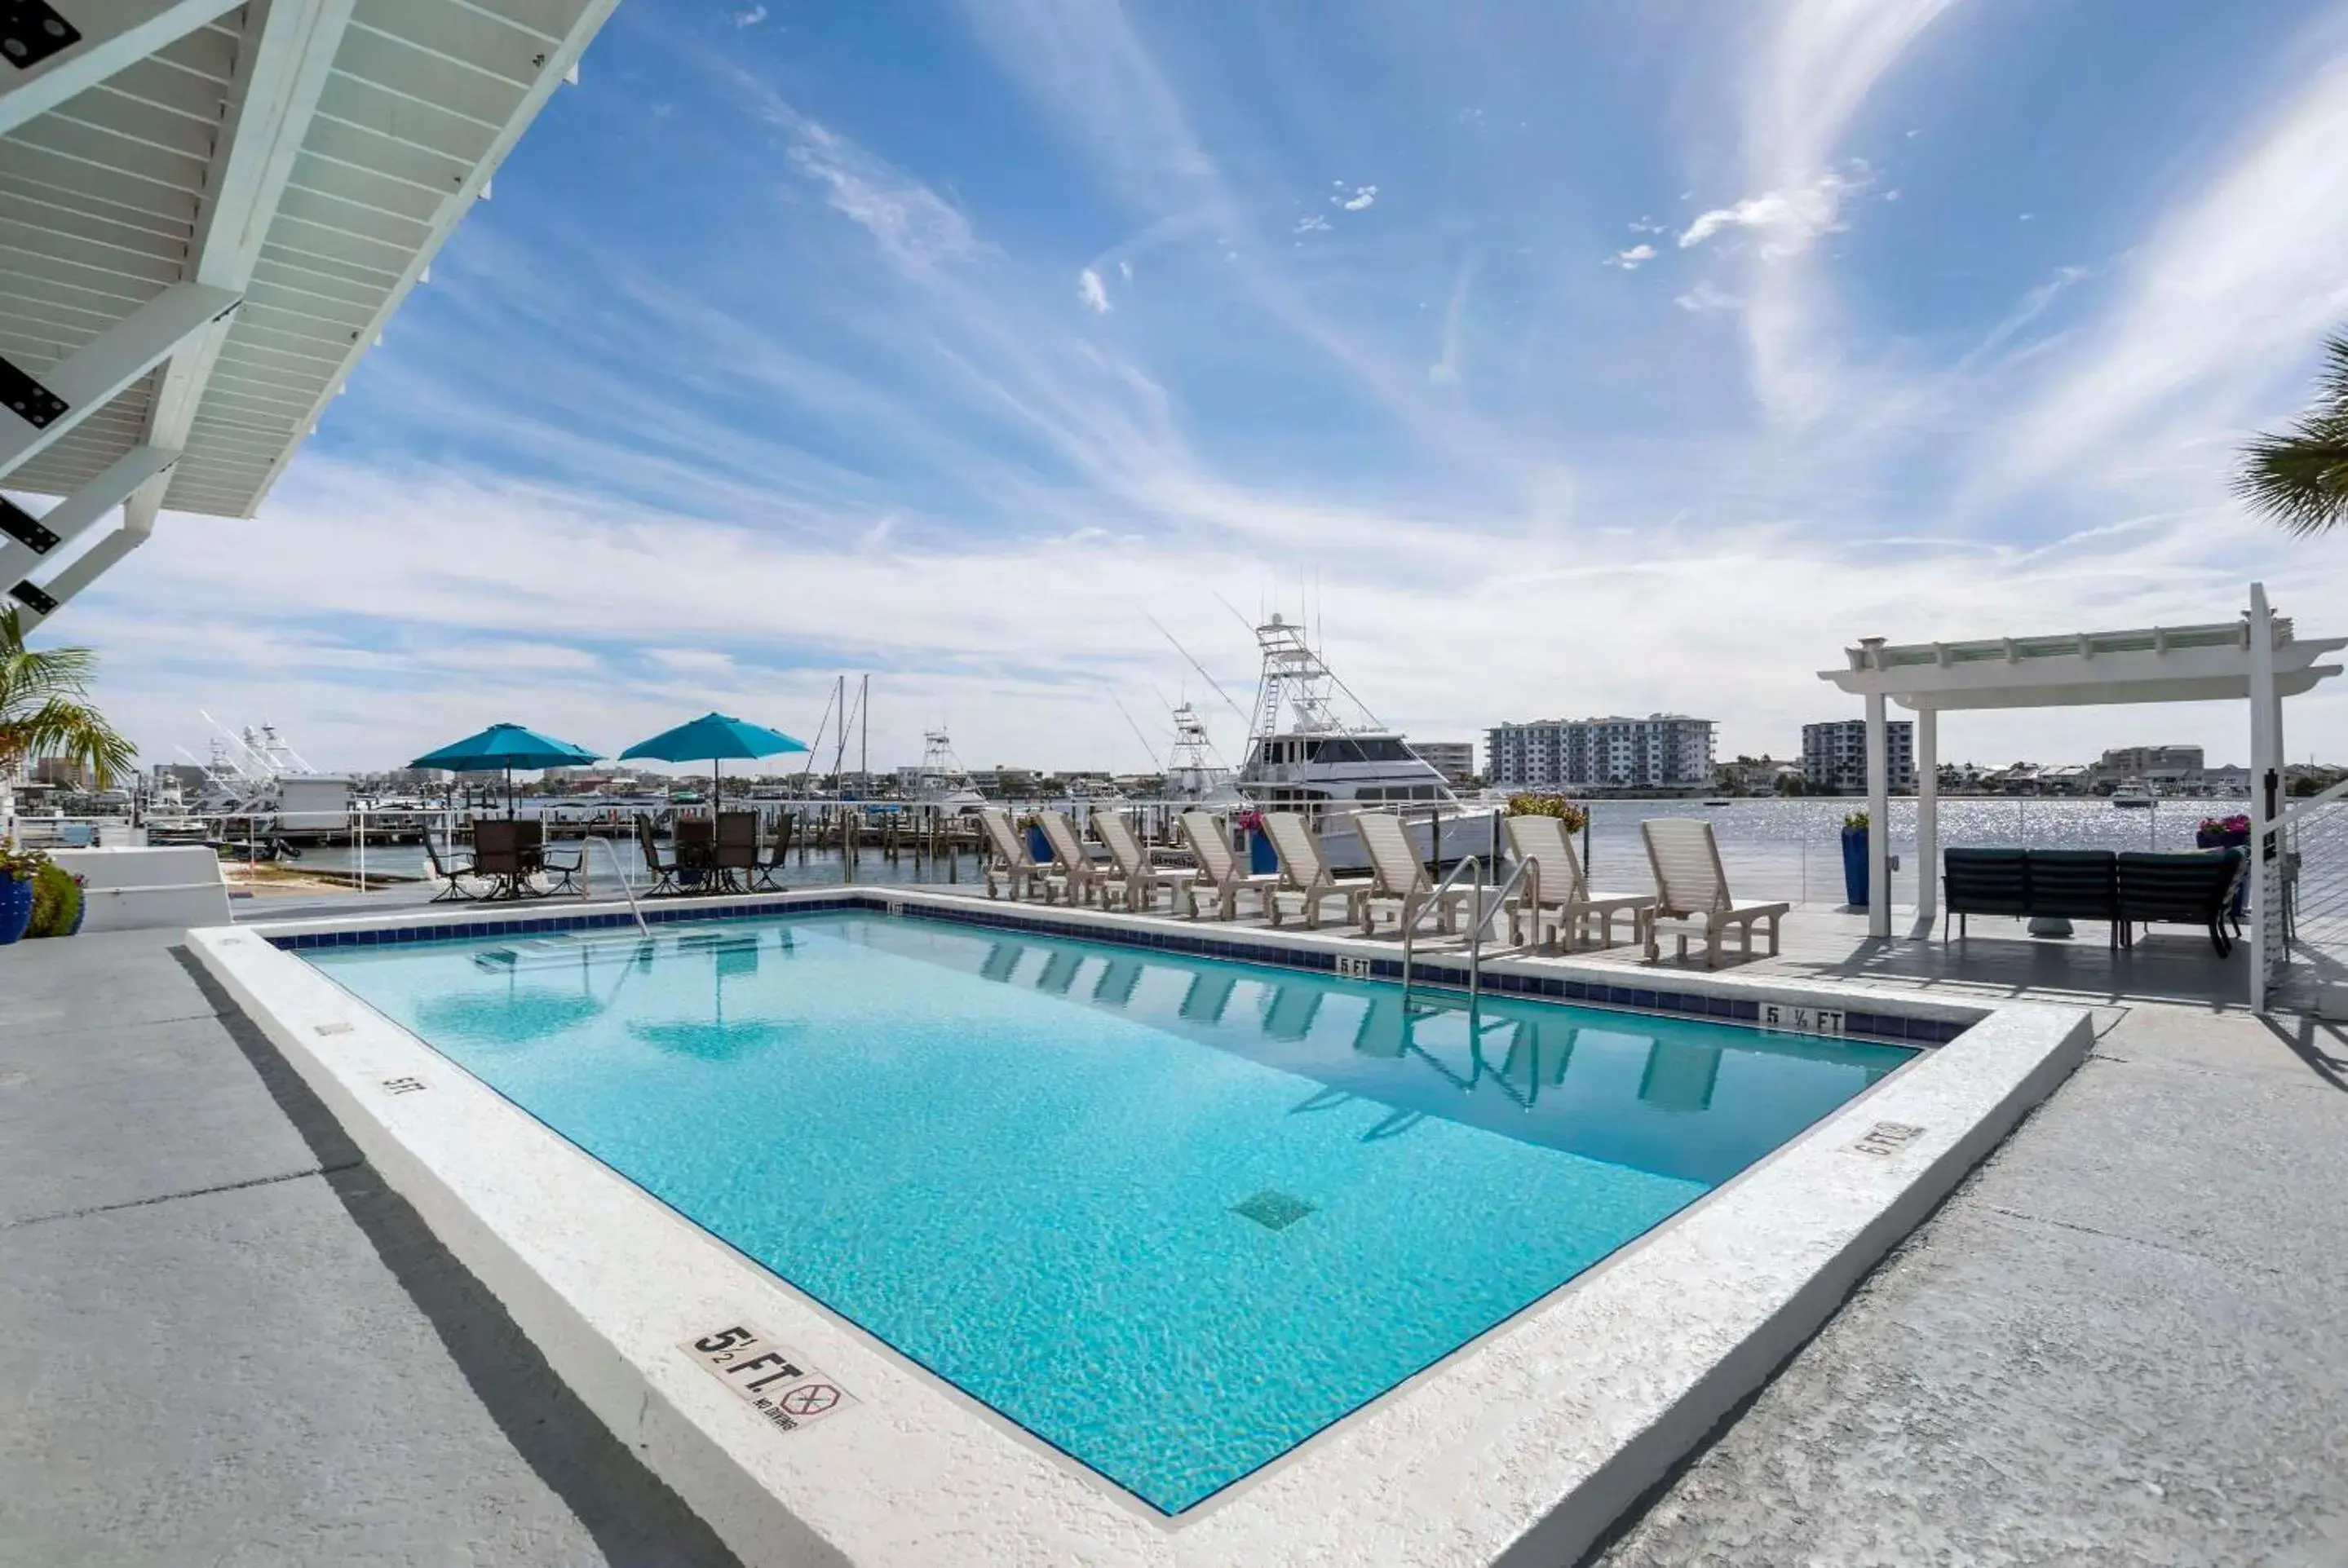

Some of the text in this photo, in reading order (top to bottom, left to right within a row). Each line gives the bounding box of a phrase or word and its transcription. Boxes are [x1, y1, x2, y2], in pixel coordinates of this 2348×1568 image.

[1354, 960, 1369, 974] FT
[1767, 1007, 1779, 1023] 5
[1816, 1011, 1842, 1031] FT
